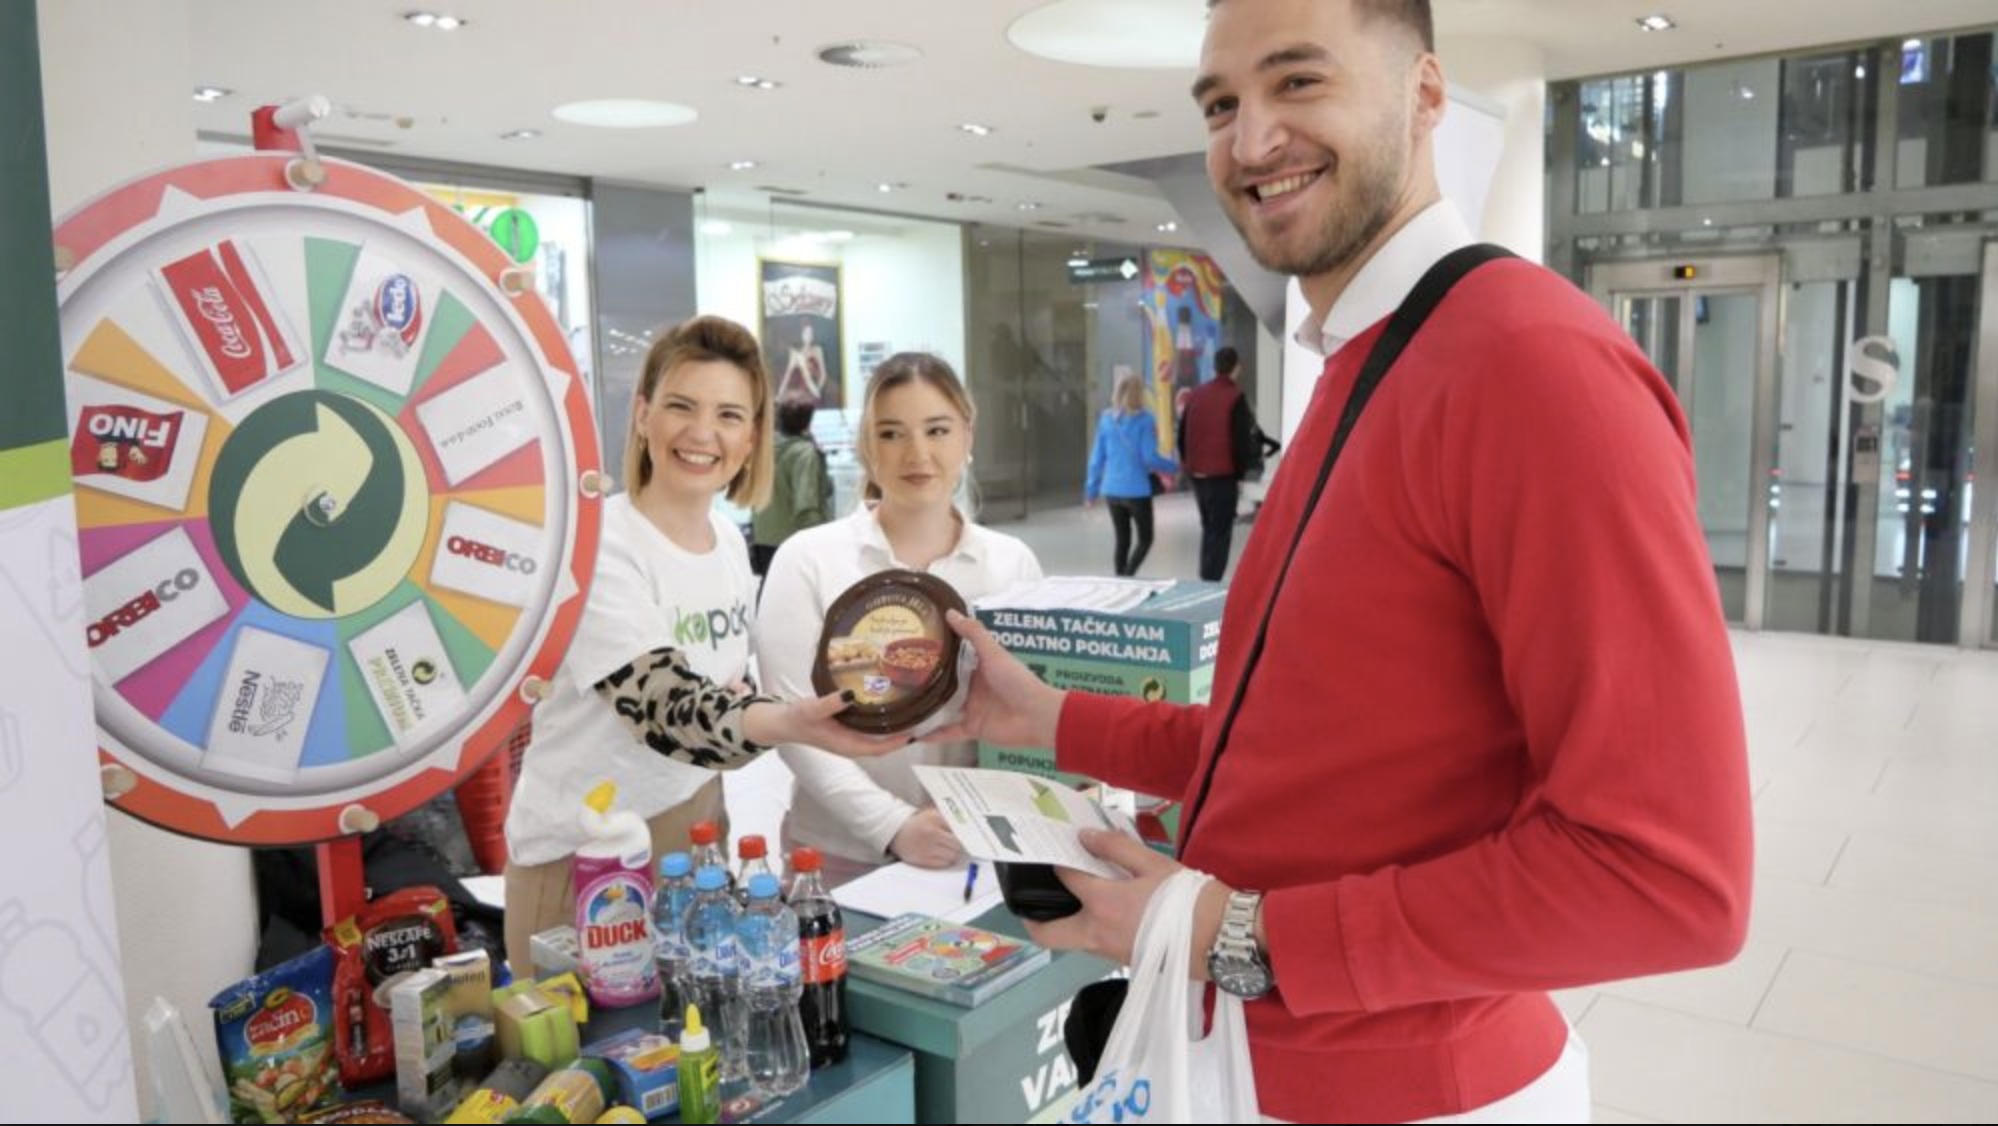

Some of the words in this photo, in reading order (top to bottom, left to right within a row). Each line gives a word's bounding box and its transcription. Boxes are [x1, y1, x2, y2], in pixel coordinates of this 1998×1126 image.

[88, 413, 172, 448] FINO
[447, 535, 537, 576] ORBICO
[86, 567, 199, 649] ORBICO
[992, 610, 1058, 632] ZELENA
[1060, 616, 1120, 638] TAČKA
[1122, 623, 1166, 642] VAM
[990, 631, 1071, 652] DODATNO
[1075, 642, 1172, 663] POKLANJA
[586, 918, 649, 949] DUCK
